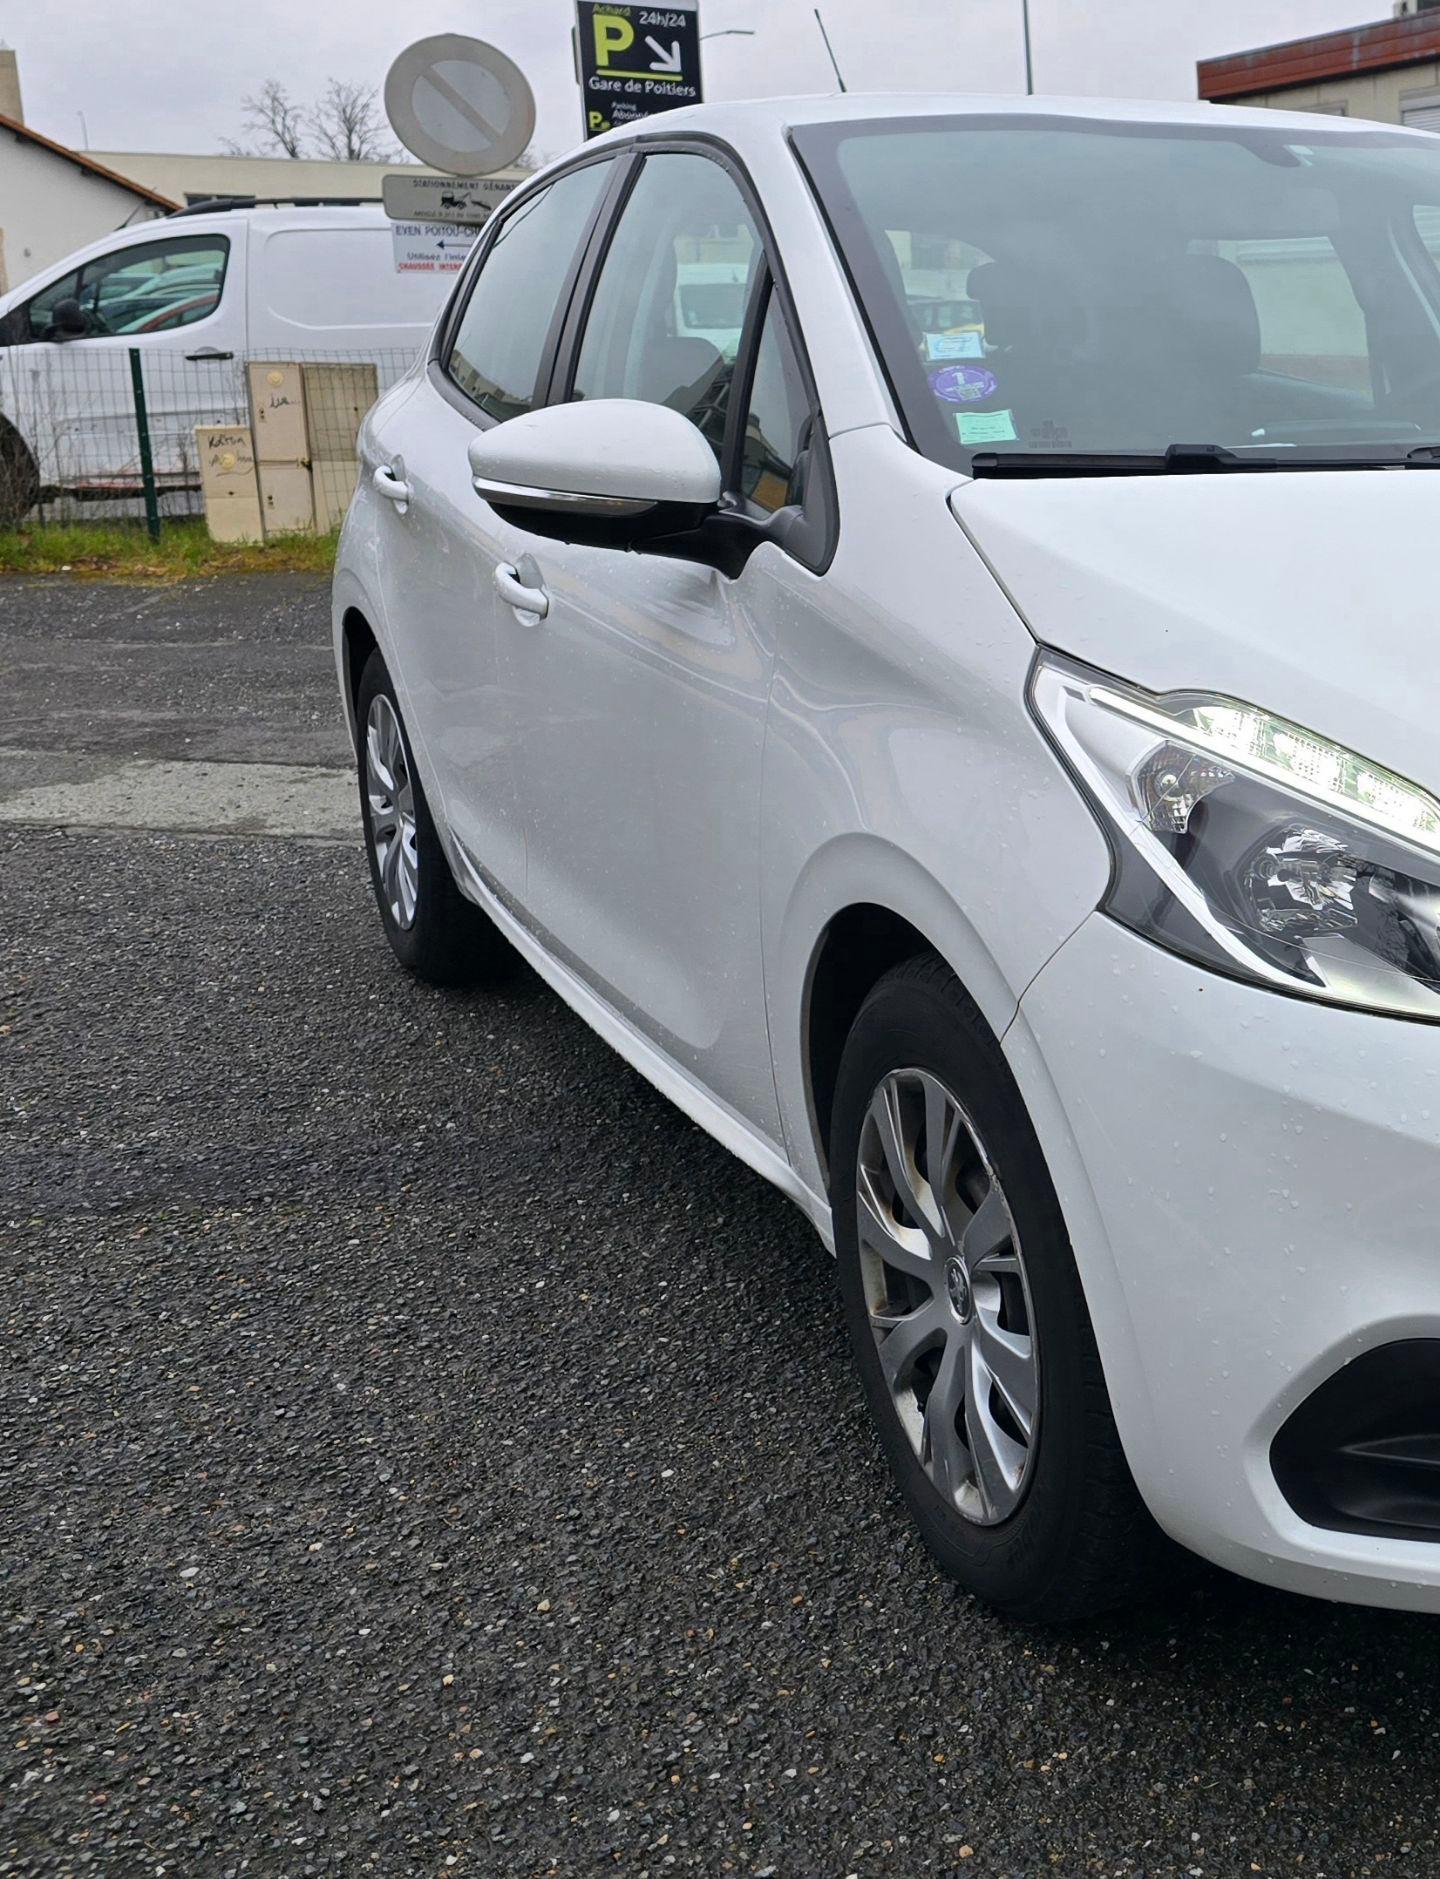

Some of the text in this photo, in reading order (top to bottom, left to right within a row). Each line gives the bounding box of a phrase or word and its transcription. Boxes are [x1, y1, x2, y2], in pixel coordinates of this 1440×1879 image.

[639, 11, 686, 27] 24h/24
[593, 14, 634, 67] P
[588, 76, 696, 97] Gare de Poitiers
[395, 225, 421, 237] EVEN
